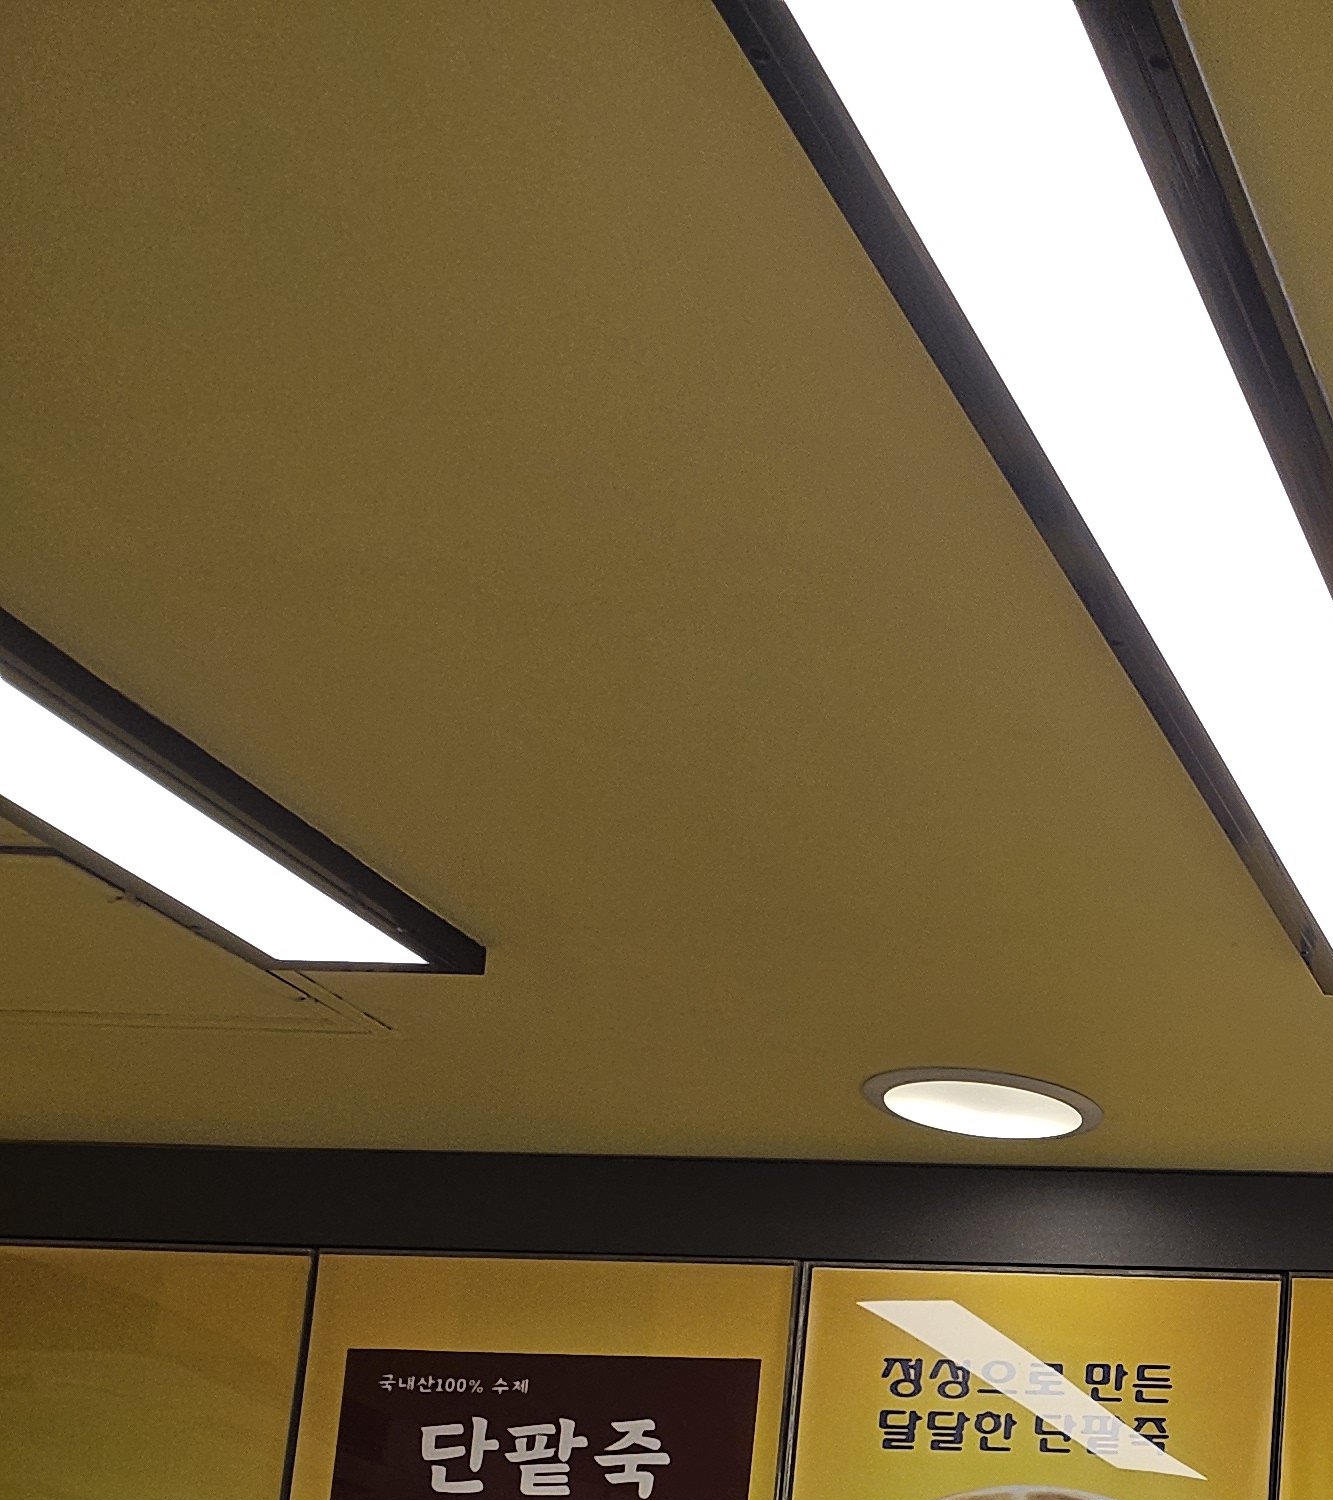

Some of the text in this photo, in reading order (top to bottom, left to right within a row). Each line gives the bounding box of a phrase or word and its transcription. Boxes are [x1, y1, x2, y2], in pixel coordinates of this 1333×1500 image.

[379, 1374, 530, 1395] 국내산100% 수제
[881, 1357, 1173, 1404] 정성으로 만든
[878, 1409, 1170, 1456] 달달한 단팥죽
[421, 1416, 671, 1500] 단팥죽
